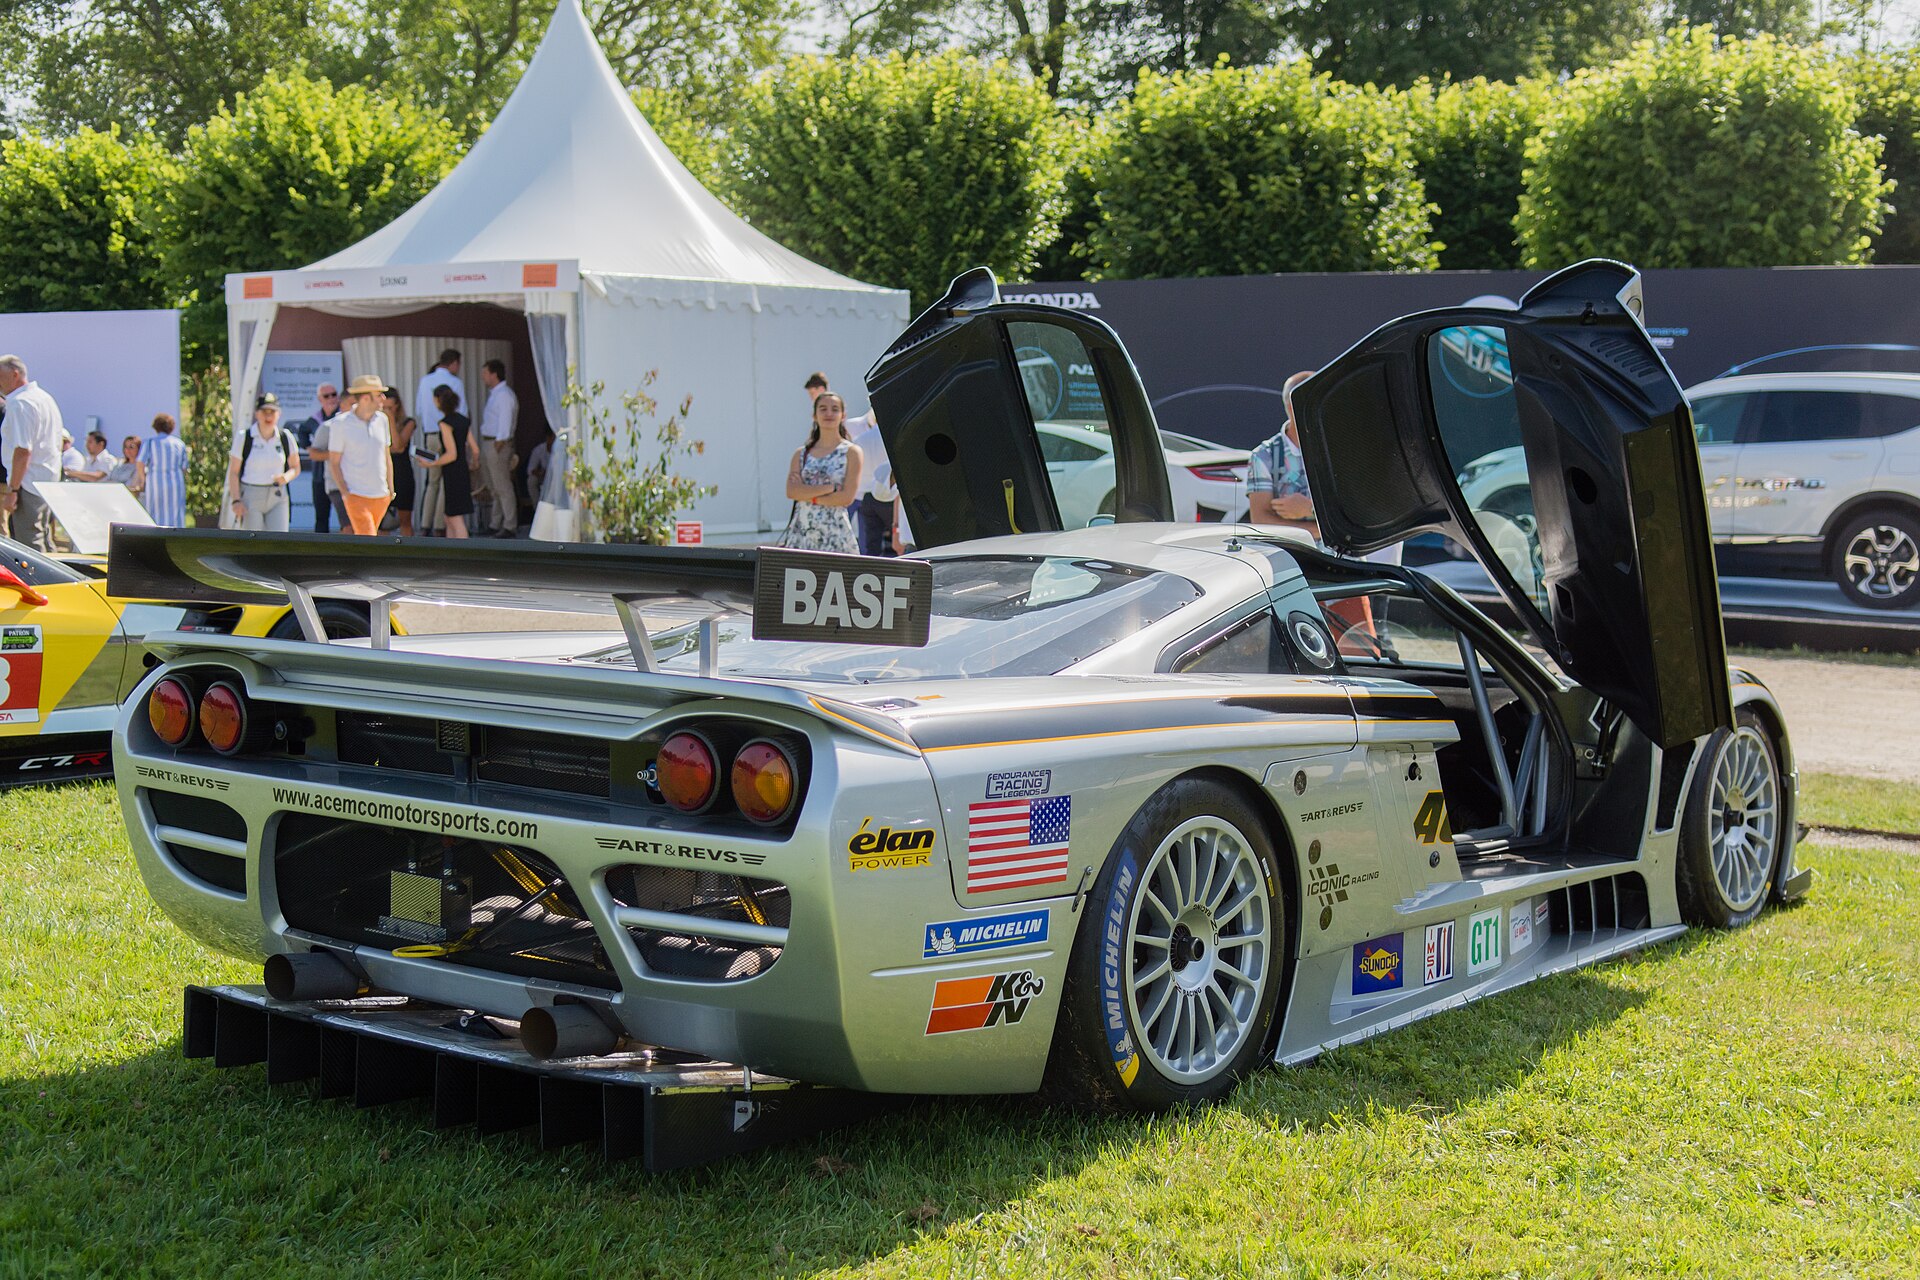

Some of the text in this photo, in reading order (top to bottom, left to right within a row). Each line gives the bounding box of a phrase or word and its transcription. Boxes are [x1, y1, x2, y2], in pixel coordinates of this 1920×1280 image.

[782, 567, 911, 630] BASF
[148, 768, 215, 789] ART&REVS
[993, 770, 1046, 780] ENDURANCE
[995, 778, 1043, 790] RACING
[1003, 788, 1041, 798] LEGENDS
[273, 787, 538, 839] www.acemcomotorsports.com
[1306, 803, 1357, 822] ART&REVS
[850, 818, 935, 854] élan
[616, 839, 739, 863] ART&REVS
[852, 855, 928, 870] POWER
[1306, 871, 1379, 896] ICONIC RACING
[959, 918, 1043, 943] MICHELIN
[1471, 914, 1499, 966] GT1
[1104, 864, 1137, 1029] MICHELIN
[1361, 953, 1399, 976] SUNOCO
